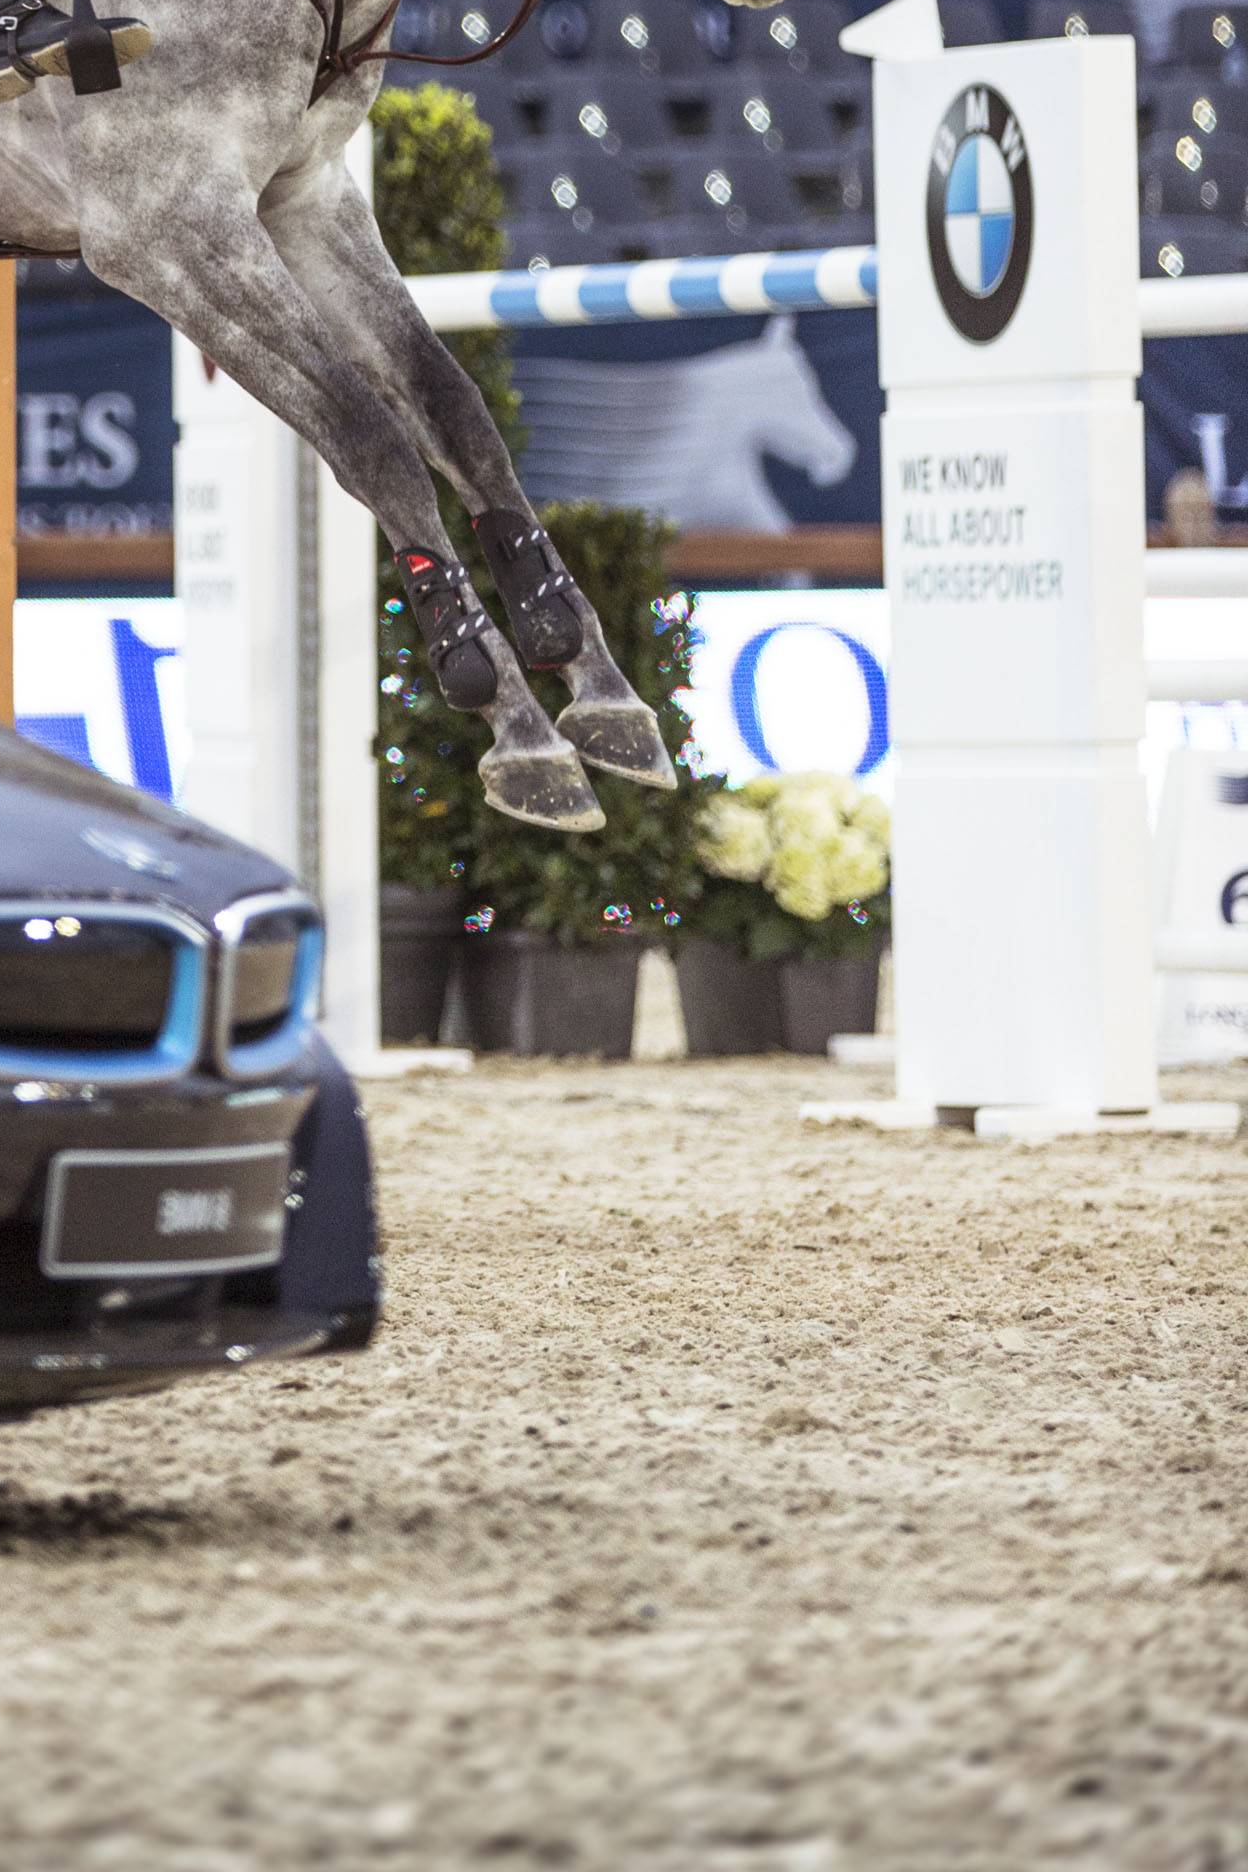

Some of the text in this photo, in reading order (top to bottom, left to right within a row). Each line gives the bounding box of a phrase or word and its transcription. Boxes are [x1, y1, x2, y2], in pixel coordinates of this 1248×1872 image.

[900, 452, 1008, 493] WE KNOW
[903, 504, 1026, 548] ALL ABOUT
[903, 559, 1064, 603] HORSEPOWER
